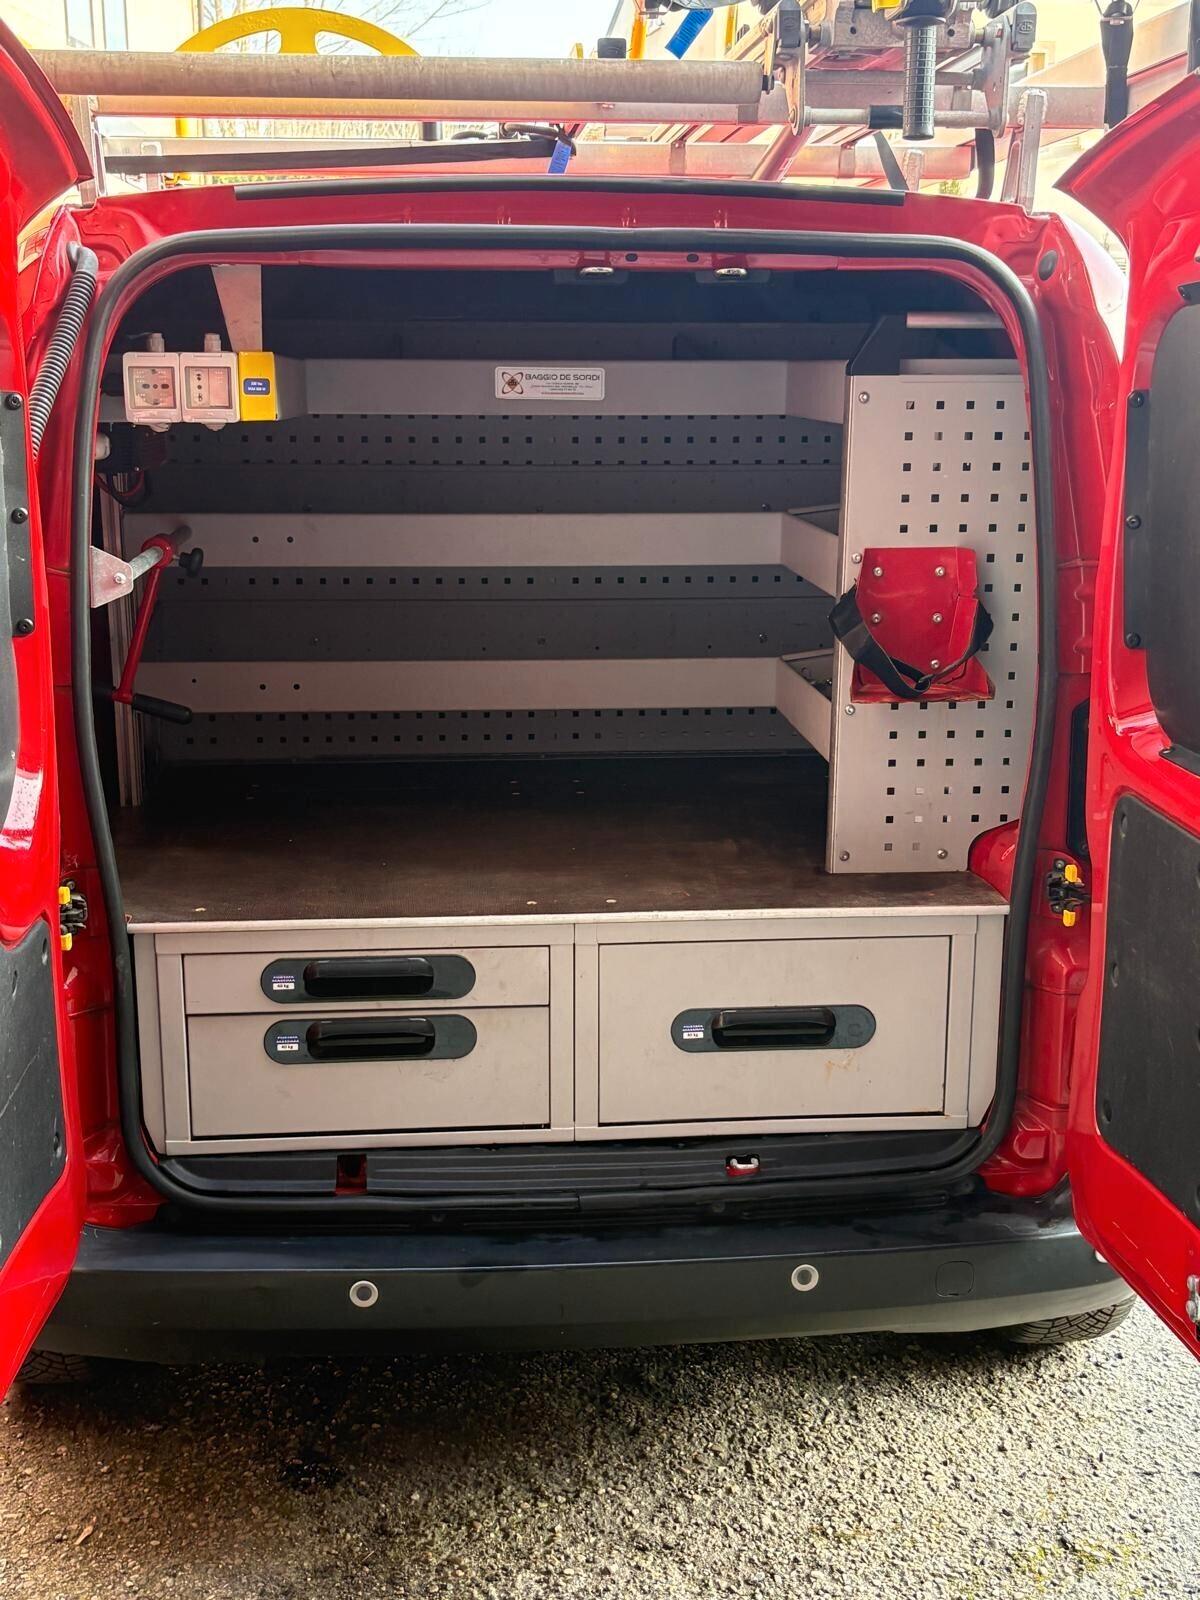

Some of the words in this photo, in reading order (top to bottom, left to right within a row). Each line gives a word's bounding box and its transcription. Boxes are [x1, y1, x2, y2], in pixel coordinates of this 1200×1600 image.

[525, 373, 558, 381] BAGGIO
[559, 373, 572, 381] DE
[572, 373, 600, 382] SORDI
